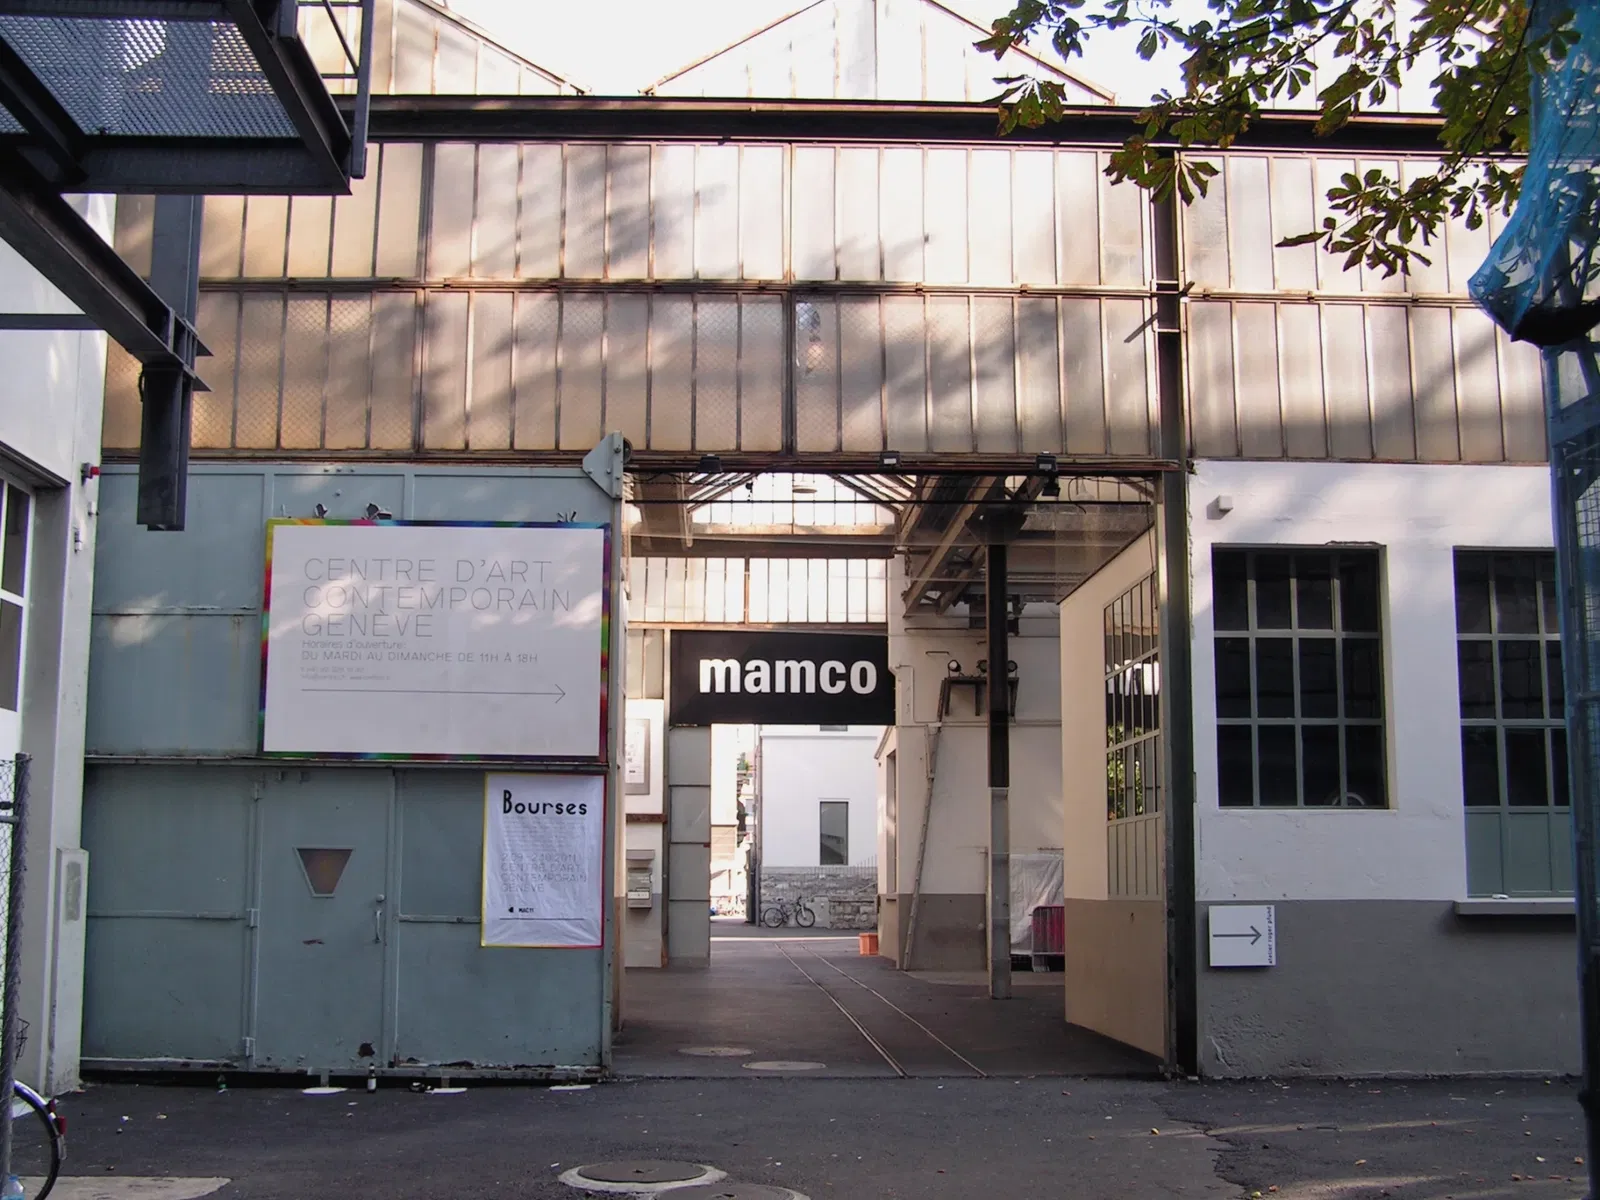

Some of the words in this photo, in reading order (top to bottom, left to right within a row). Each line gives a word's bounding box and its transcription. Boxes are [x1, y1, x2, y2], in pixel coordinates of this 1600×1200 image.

[303, 558, 436, 583] CENTRE
[456, 559, 552, 584] D'ART
[303, 586, 570, 611] CONTEMPORAIN
[302, 609, 434, 638] GENÈVE
[301, 651, 318, 661] DU
[323, 651, 362, 661] MARDI
[366, 652, 384, 662] AU
[388, 652, 452, 662] DIMANCHE
[458, 652, 475, 663] DE
[479, 652, 499, 663] 11H
[516, 652, 538, 663] 18H
[302, 640, 343, 649] Horaires
[699, 657, 878, 695] mamco
[503, 789, 588, 816] Bourses
